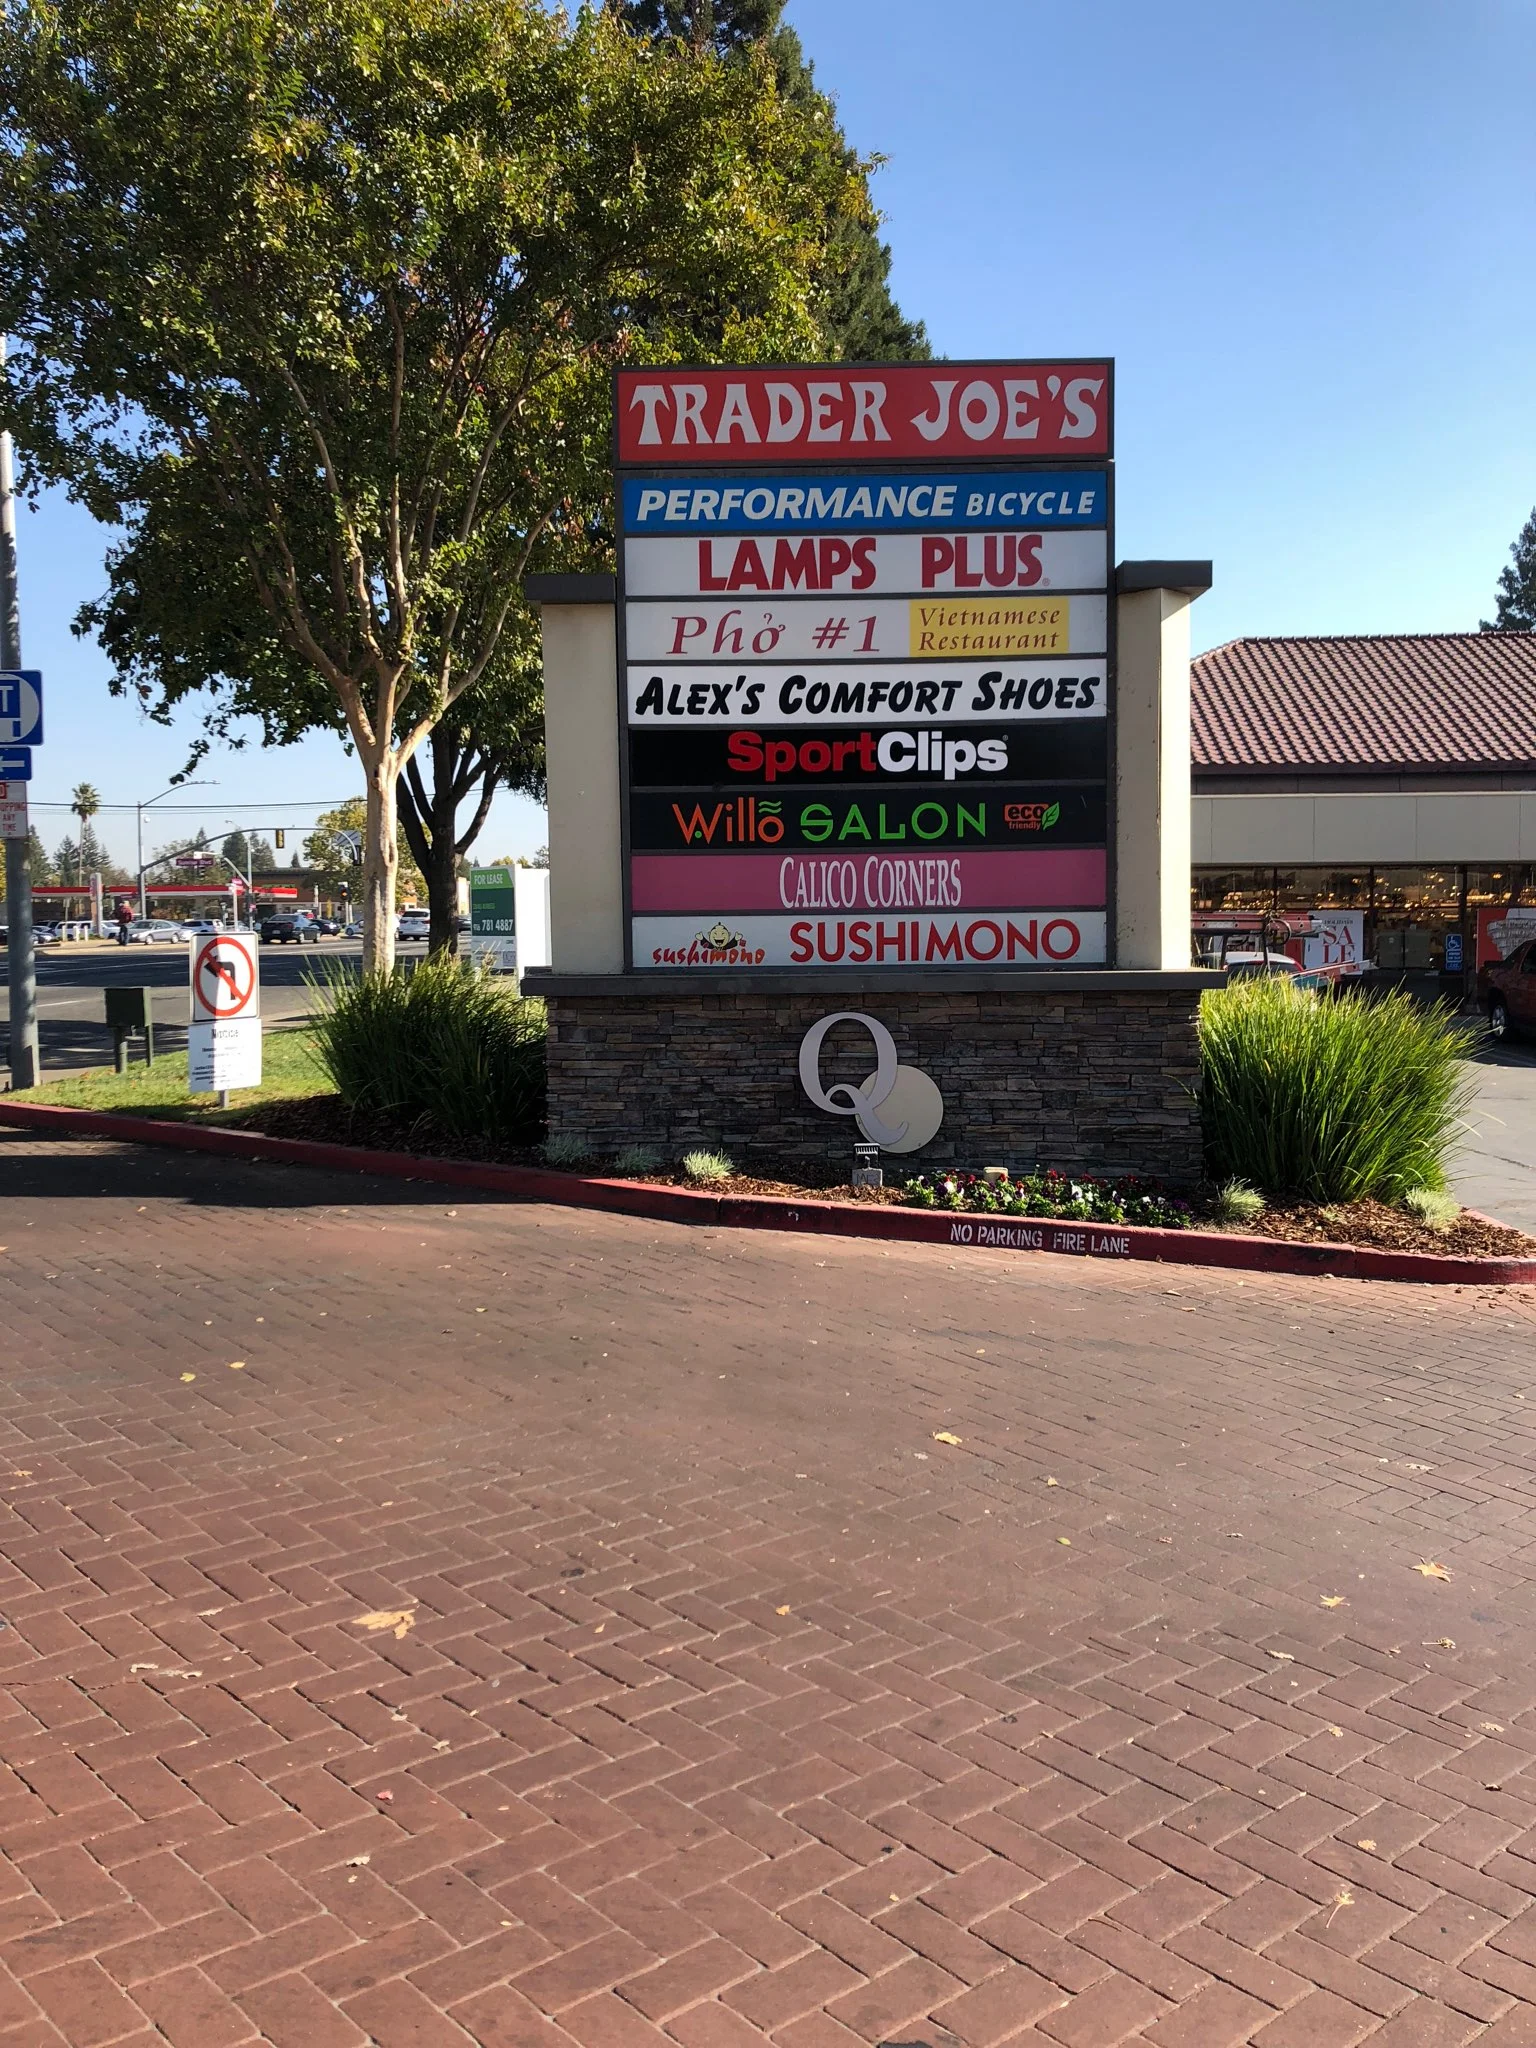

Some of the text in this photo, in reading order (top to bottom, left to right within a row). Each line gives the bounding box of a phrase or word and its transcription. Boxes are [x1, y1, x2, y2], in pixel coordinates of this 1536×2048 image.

[629, 375, 1104, 445] TRADER JOE'S
[637, 485, 1095, 521] PERFORMANCE BICYCLE
[699, 534, 1043, 591] LAMPS PLUS
[812, 615, 880, 652] #1
[918, 607, 1060, 627] Vietnamese
[918, 631, 1060, 650] Restaurant
[635, 671, 1101, 716] ALEX'S COMFORT SHOES
[800, 802, 986, 841] SALON
[1008, 805, 1044, 820] eco
[1009, 820, 1041, 831] friendly
[474, 873, 503, 885] FOR LEASE
[779, 855, 962, 910] CALICO CORNERS
[482, 919, 494, 931] 781
[495, 919, 514, 932] 4887
[652, 918, 1081, 966] sushimono SUSHIMONO
[799, 1011, 909, 1146] Q
[950, 1223, 1131, 1254] NO PARKING FIRE LANE
